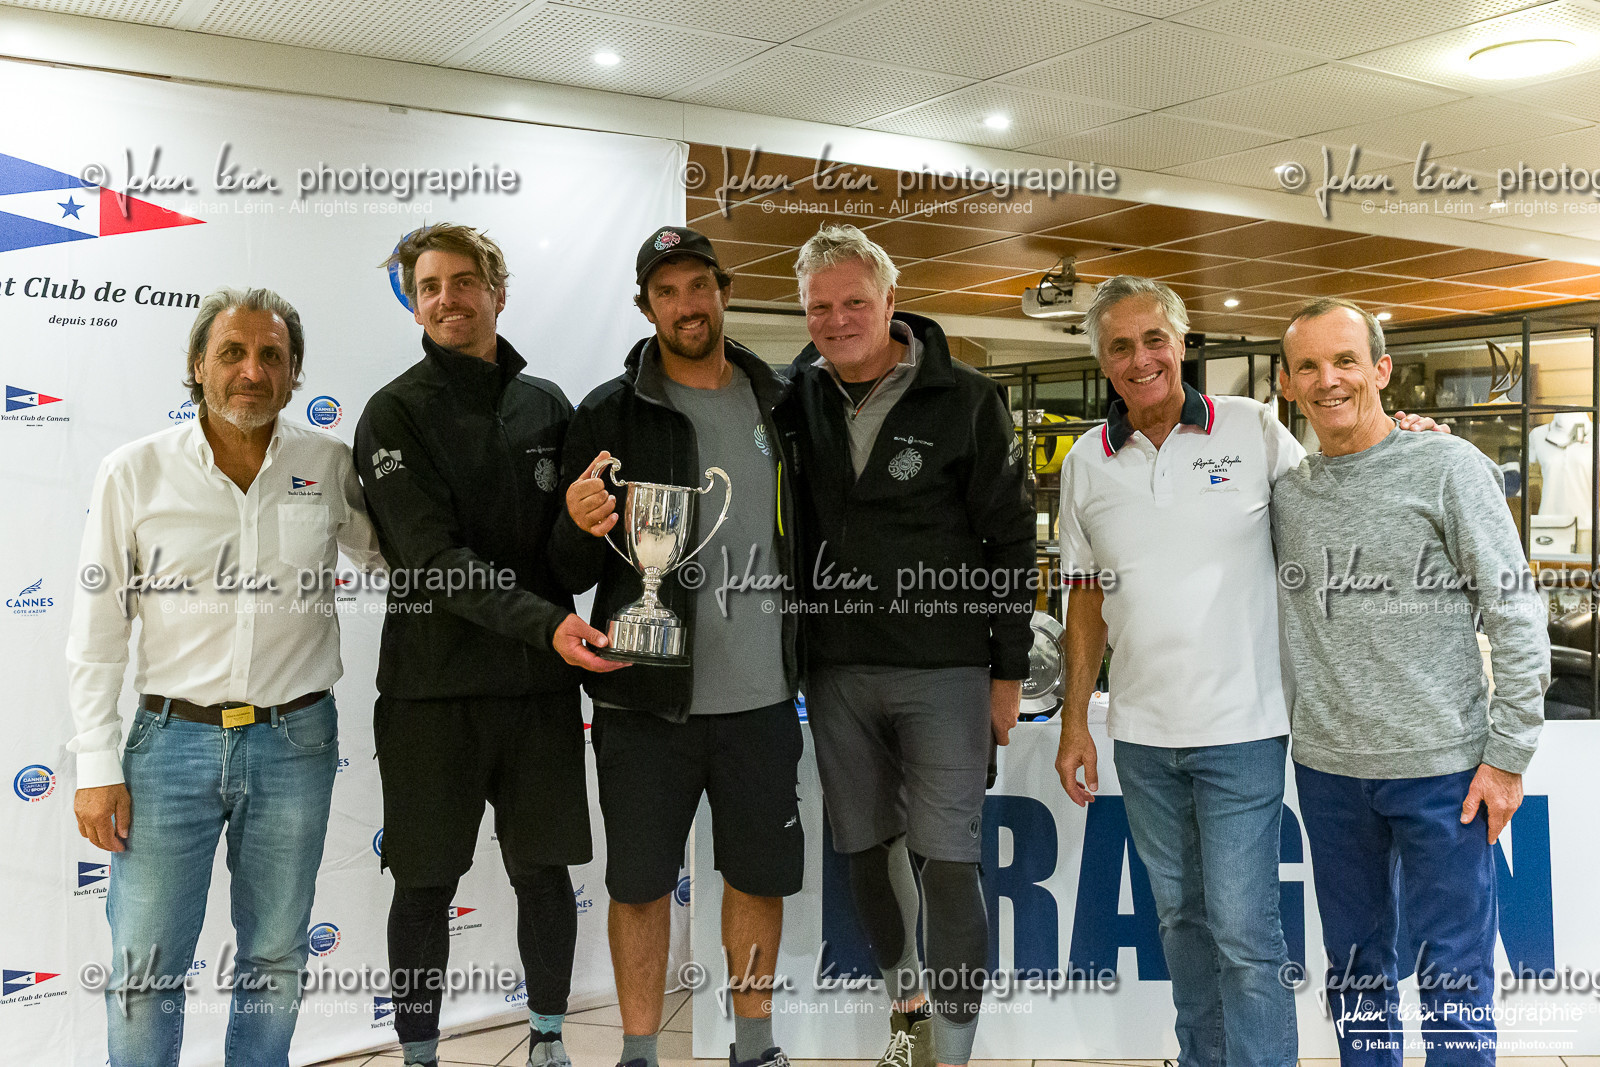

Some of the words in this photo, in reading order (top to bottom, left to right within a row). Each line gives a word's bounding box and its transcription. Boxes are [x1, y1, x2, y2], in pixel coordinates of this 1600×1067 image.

[24, 276, 86, 300] Club
[94, 281, 127, 303] de
[134, 285, 201, 308] Cann
[48, 315, 87, 327] depuis
[90, 317, 118, 328] 1860
[168, 410, 196, 419] CANN
[6, 597, 54, 608] CANNES
[43, 990, 68, 998] Cannes
[505, 992, 528, 1003] CANN
